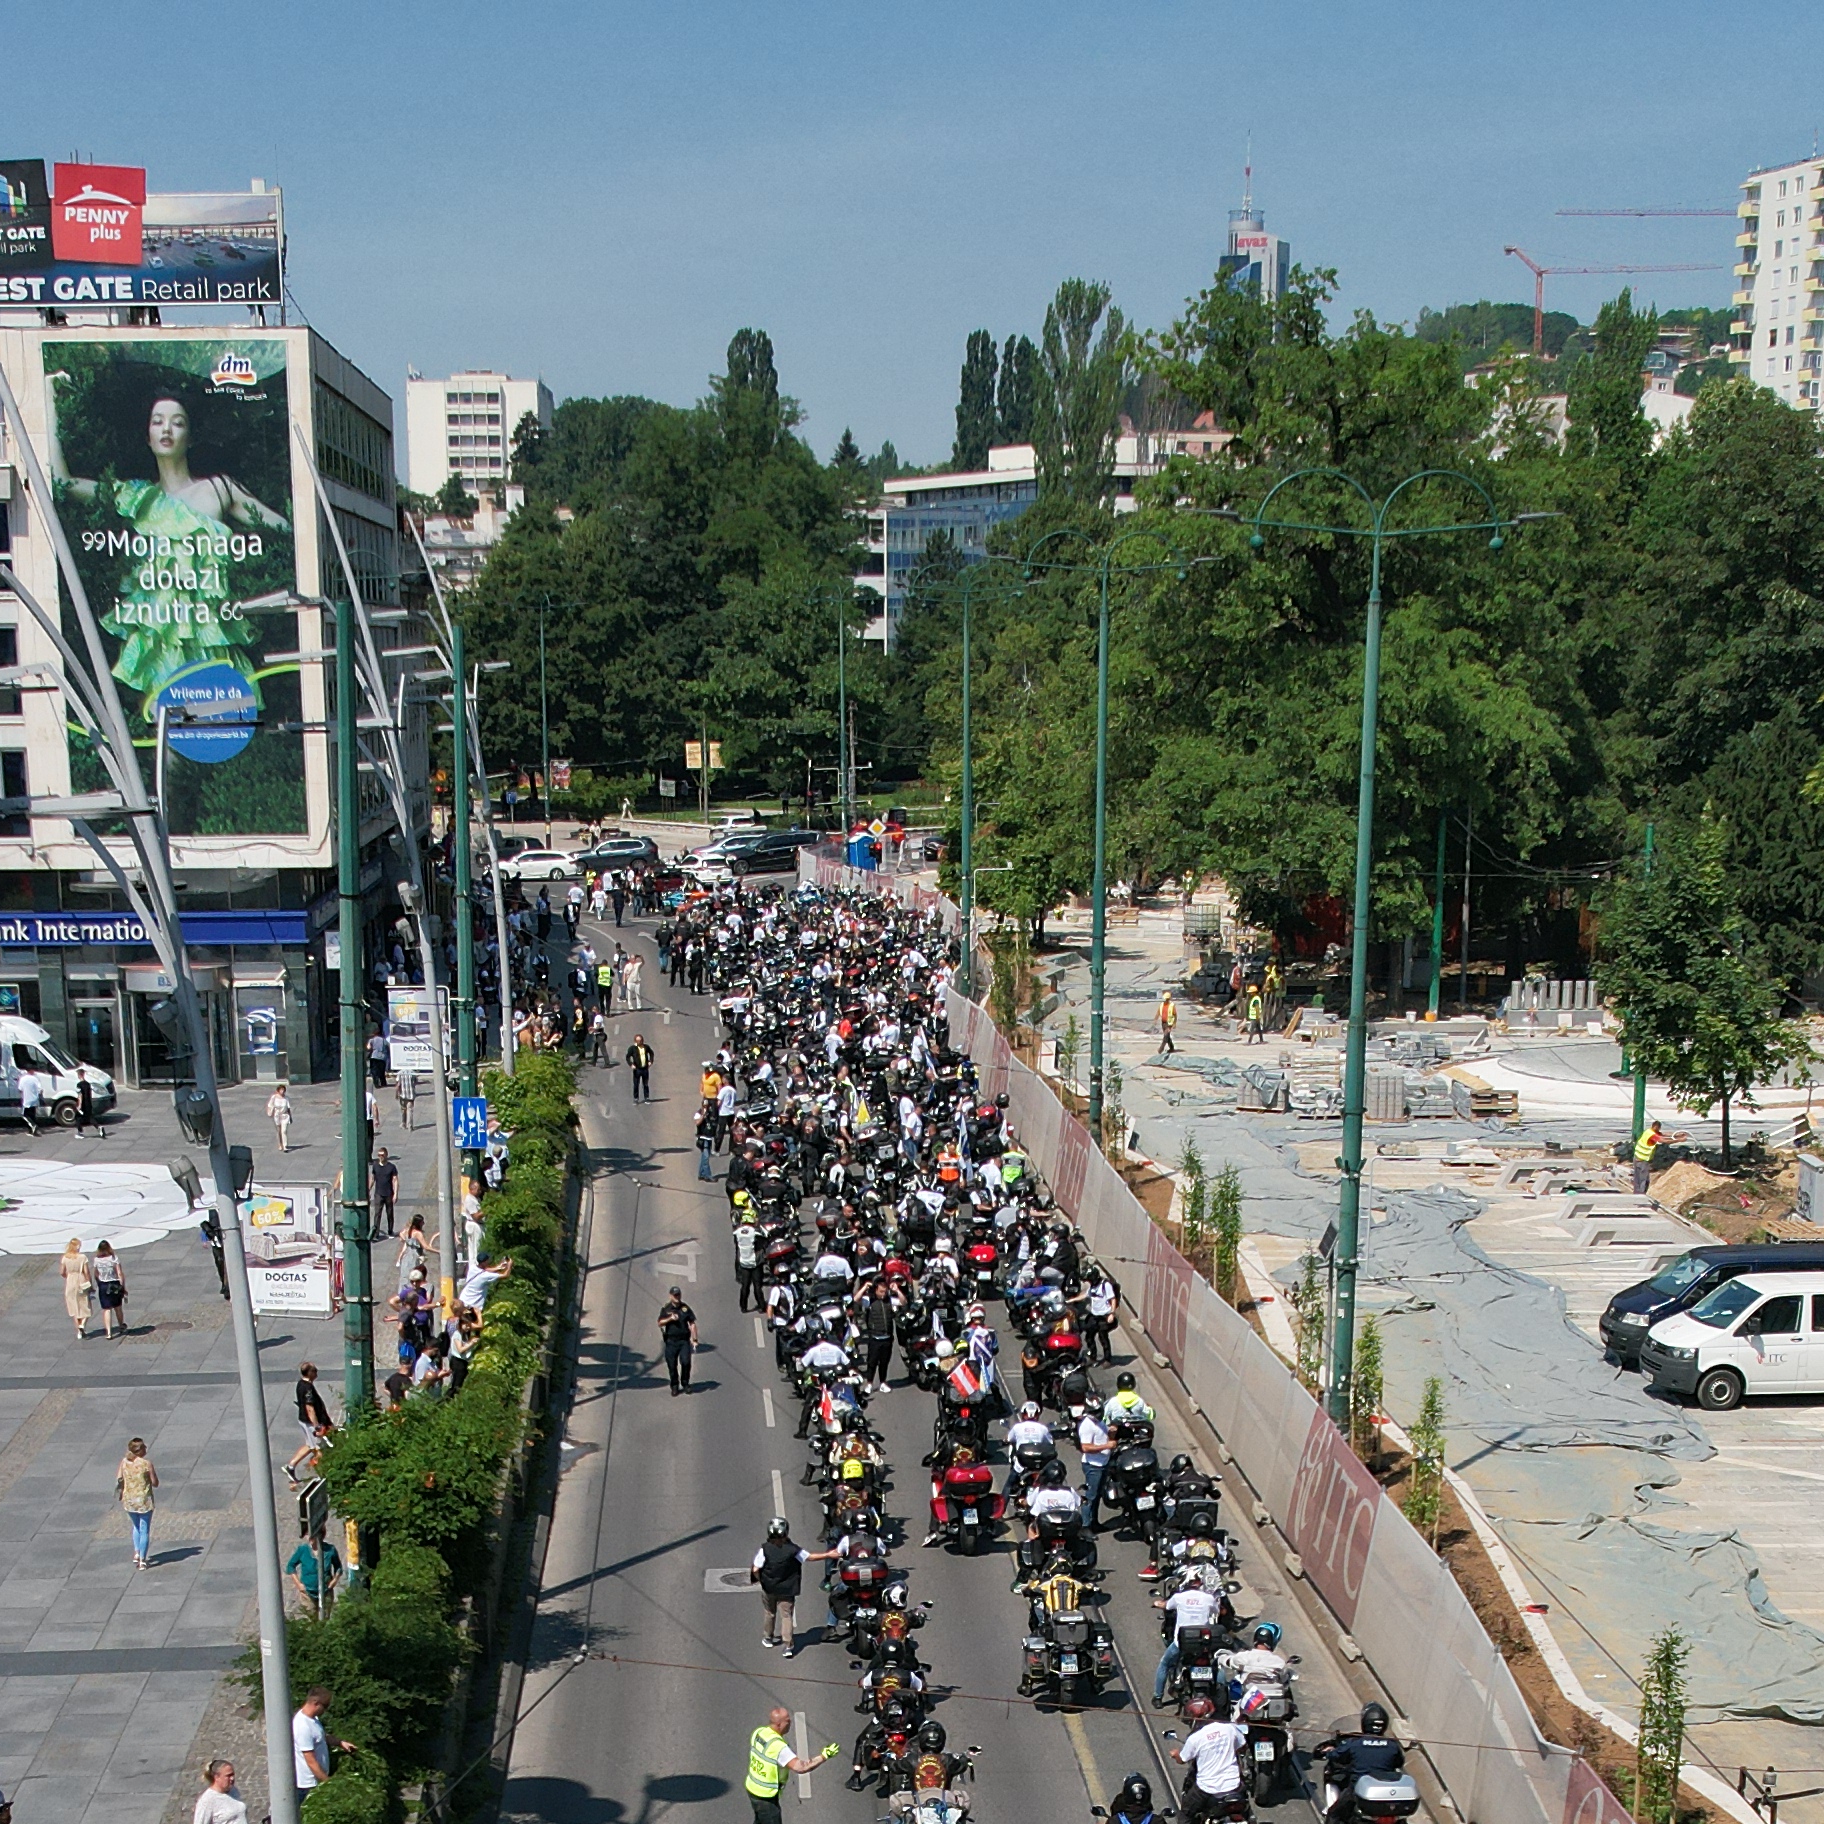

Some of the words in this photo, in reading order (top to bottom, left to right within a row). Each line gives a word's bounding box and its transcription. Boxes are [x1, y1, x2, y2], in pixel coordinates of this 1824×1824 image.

[64, 207, 129, 224] PENNY
[6, 227, 46, 240] GATE
[90, 224, 121, 242] plus
[9, 243, 37, 256] park
[53, 276, 133, 301] GATE
[142, 278, 209, 301] Retail
[217, 278, 271, 303] park
[220, 354, 250, 374] dm
[182, 534, 263, 562] snaga
[139, 563, 220, 590] dolazi
[228, 686, 242, 699] da
[36, 919, 151, 942] Internatio
[1159, 1264, 1190, 1360] ITC
[1769, 1353, 1788, 1363] ITC
[1312, 1458, 1375, 1601] ITC
